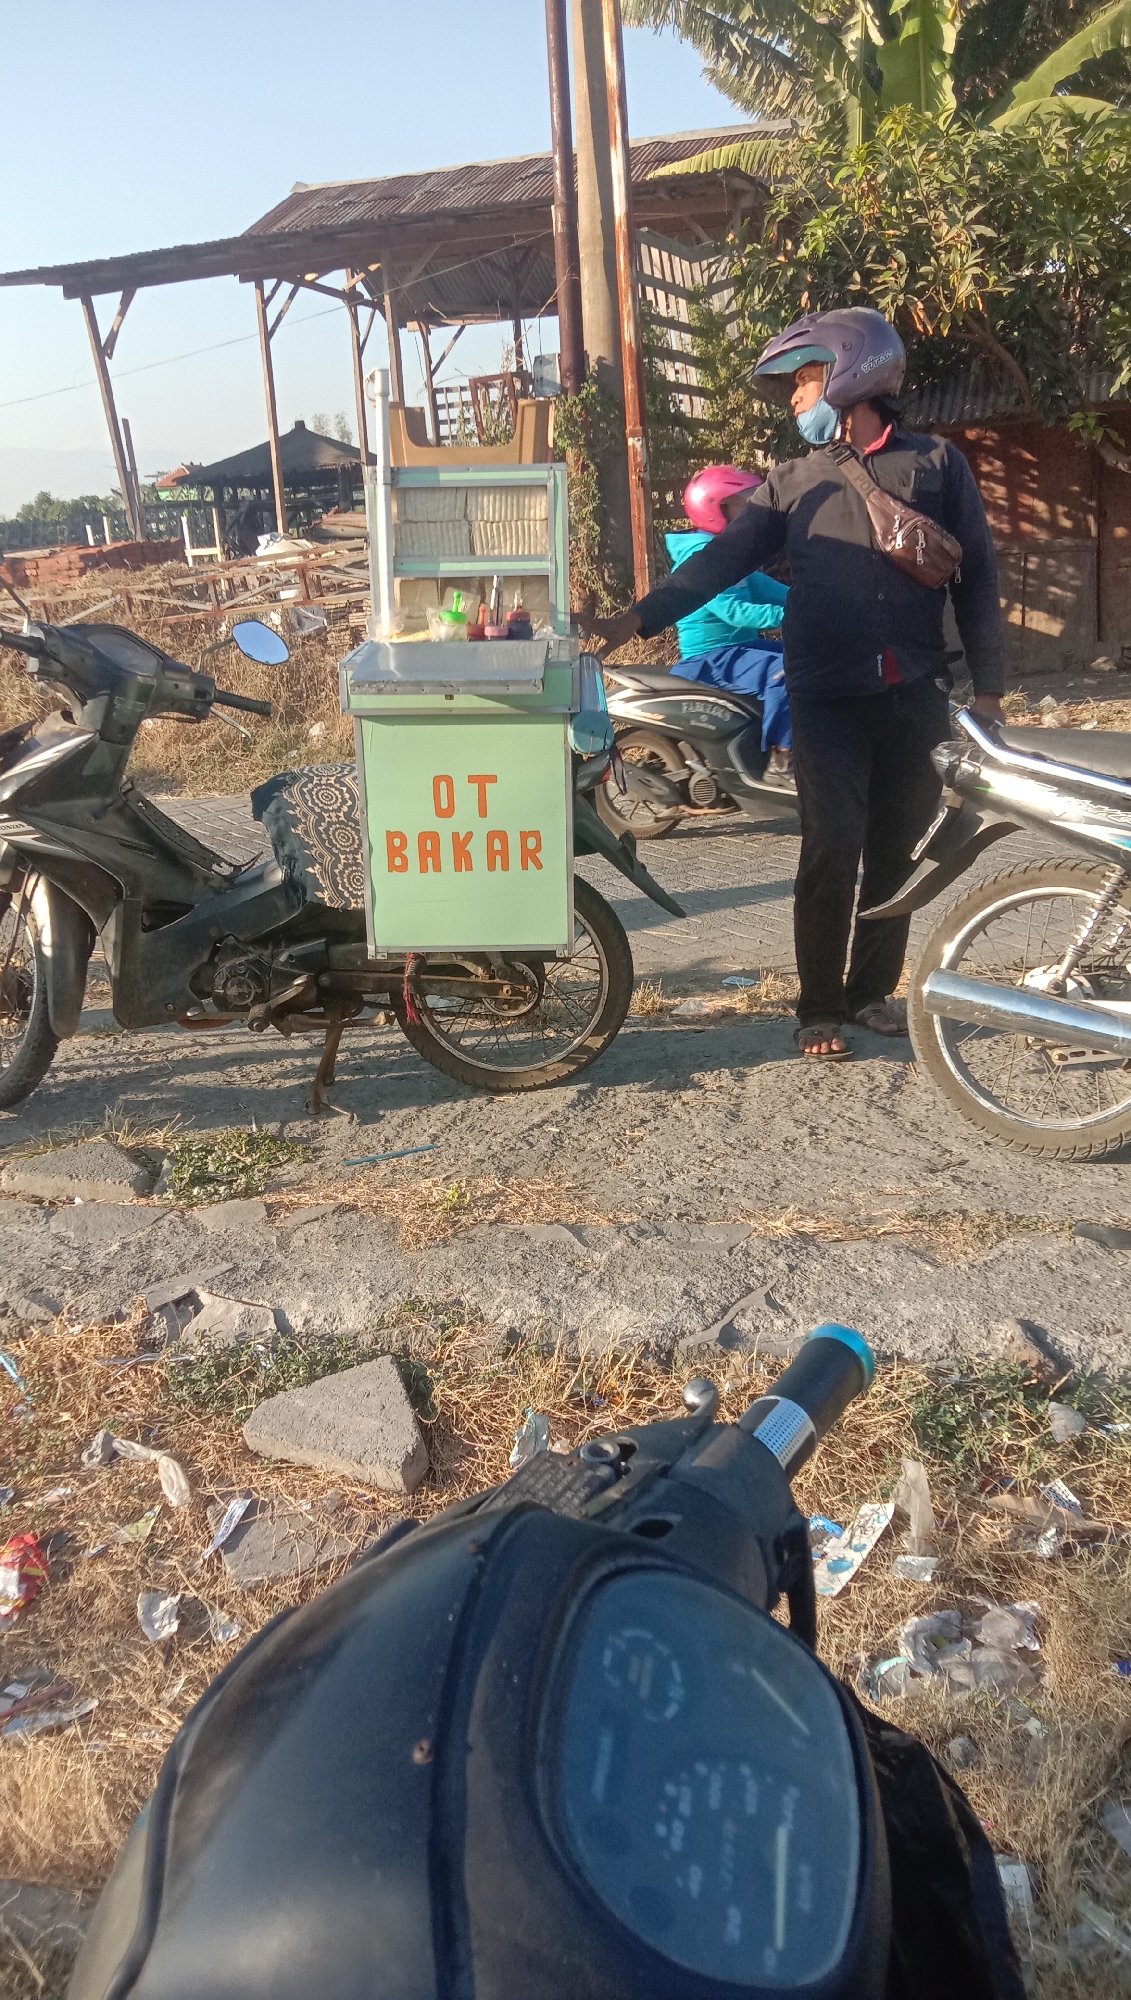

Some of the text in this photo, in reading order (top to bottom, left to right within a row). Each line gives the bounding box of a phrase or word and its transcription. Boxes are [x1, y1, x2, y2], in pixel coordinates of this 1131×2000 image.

[433, 775, 498, 819] OT
[0, 823, 25, 831] ONDA
[386, 830, 544, 873] BAKAR
